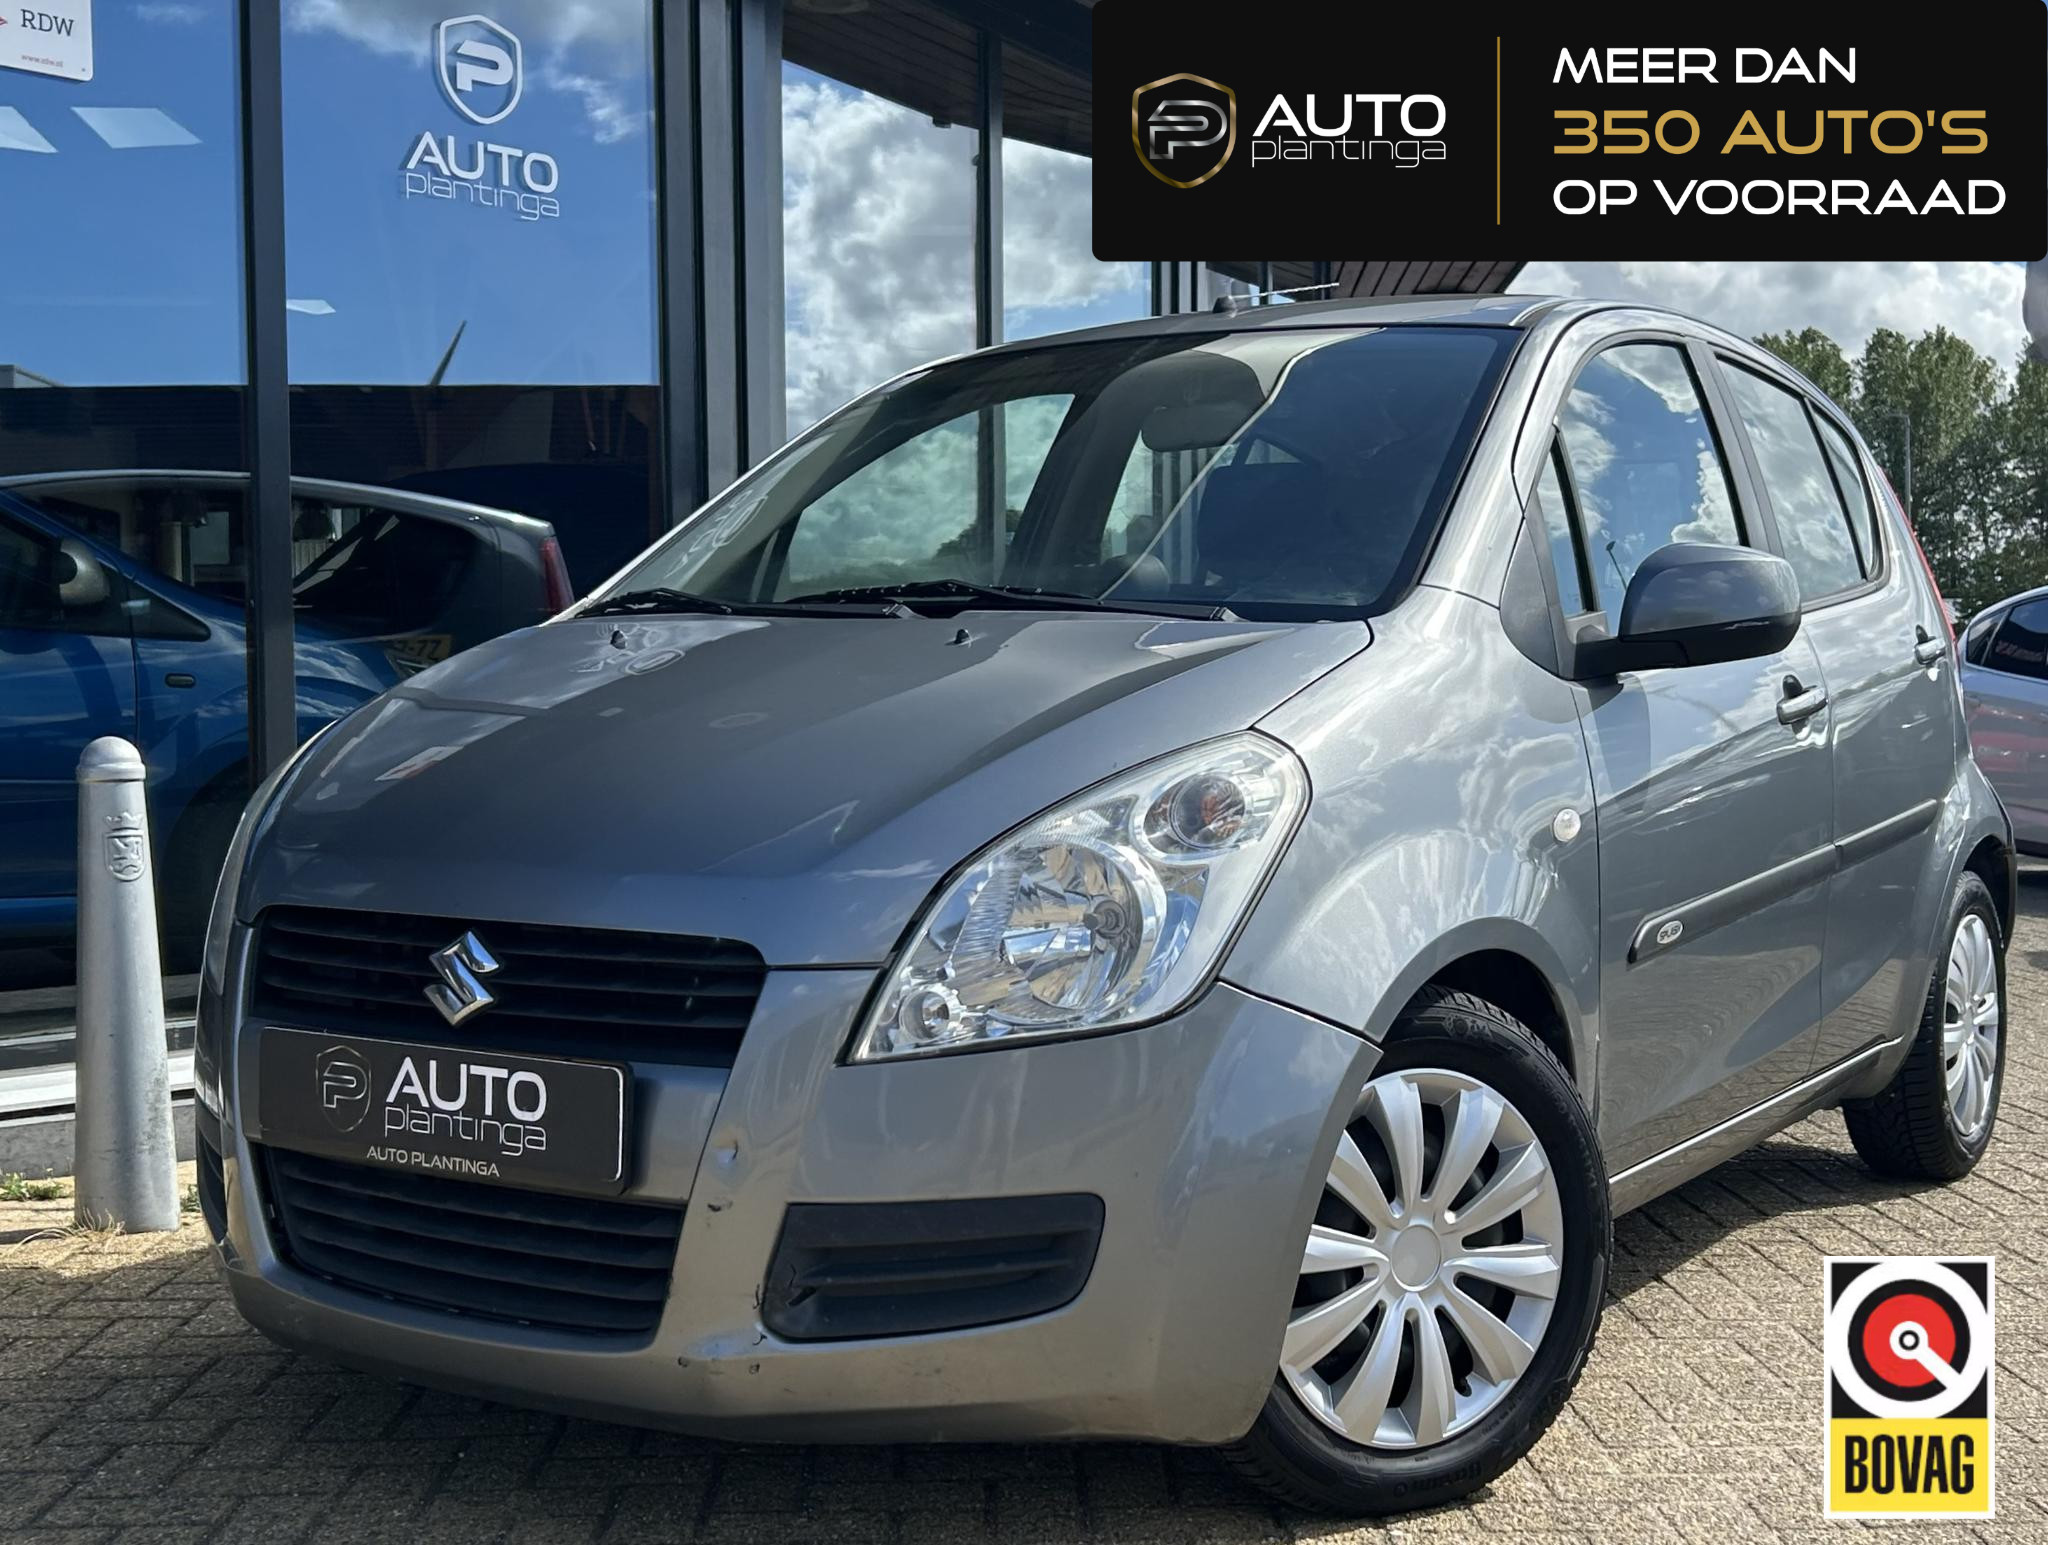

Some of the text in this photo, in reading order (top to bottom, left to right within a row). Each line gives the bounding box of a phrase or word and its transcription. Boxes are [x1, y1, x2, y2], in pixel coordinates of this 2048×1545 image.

[20, 8, 75, 37] RDW
[406, 131, 559, 194] AUTO
[405, 171, 560, 221] plantinga
[385, 1056, 548, 1122] AUTO
[384, 1105, 547, 1156] plantinga
[366, 1145, 500, 1177] AUTO PLANTINGA
